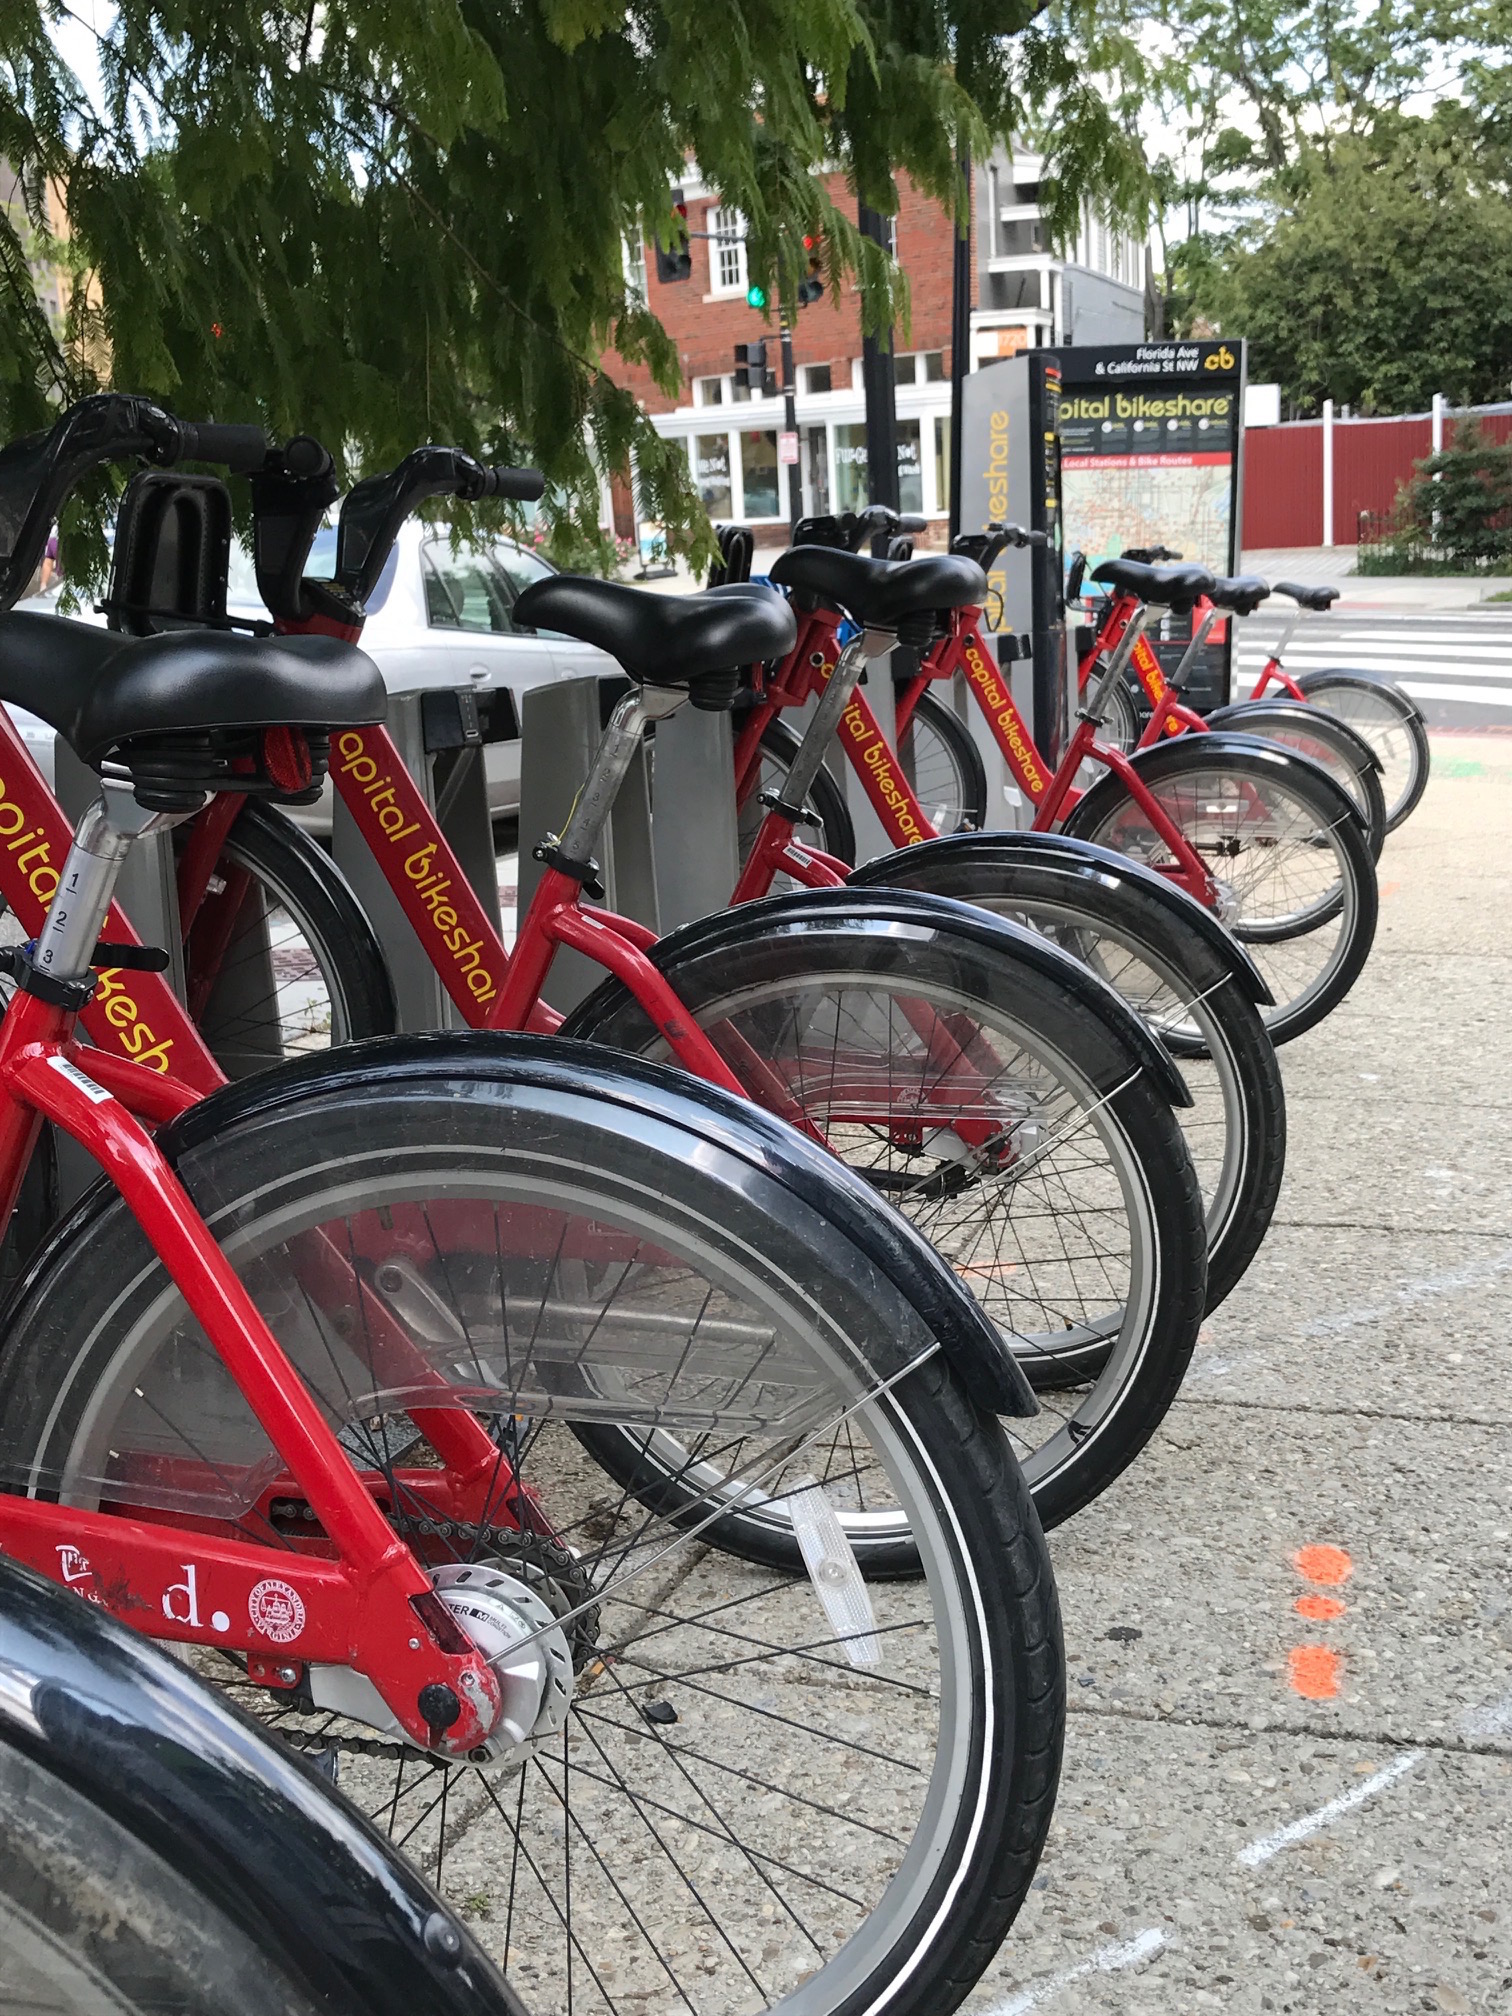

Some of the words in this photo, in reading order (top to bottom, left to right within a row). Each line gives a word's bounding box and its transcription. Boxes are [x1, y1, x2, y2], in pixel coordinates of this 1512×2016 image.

[1136, 346, 1176, 361] Florida
[1177, 345, 1199, 359] Ave
[1095, 361, 1106, 375] &
[1106, 357, 1160, 375] California
[1162, 358, 1175, 373] St
[1176, 358, 1199, 372] NW
[1059, 394, 1110, 422] pital
[1115, 392, 1229, 418] bikeshare
[983, 410, 1010, 525] keshare
[1064, 456, 1088, 468] Local
[1090, 454, 1127, 467] Stations
[1129, 454, 1137, 465] &
[1138, 453, 1158, 465] Bike
[1159, 452, 1193, 465] Routes
[965, 648, 1006, 710] capital
[997, 708, 1043, 793] bikeshare
[863, 741, 924, 845] bikeshare
[72, 873, 80, 888] 1
[338, 732, 421, 843] apital
[404, 842, 498, 1015] bikeshar
[55, 911, 68, 927] 2
[42, 949, 54, 964] 3
